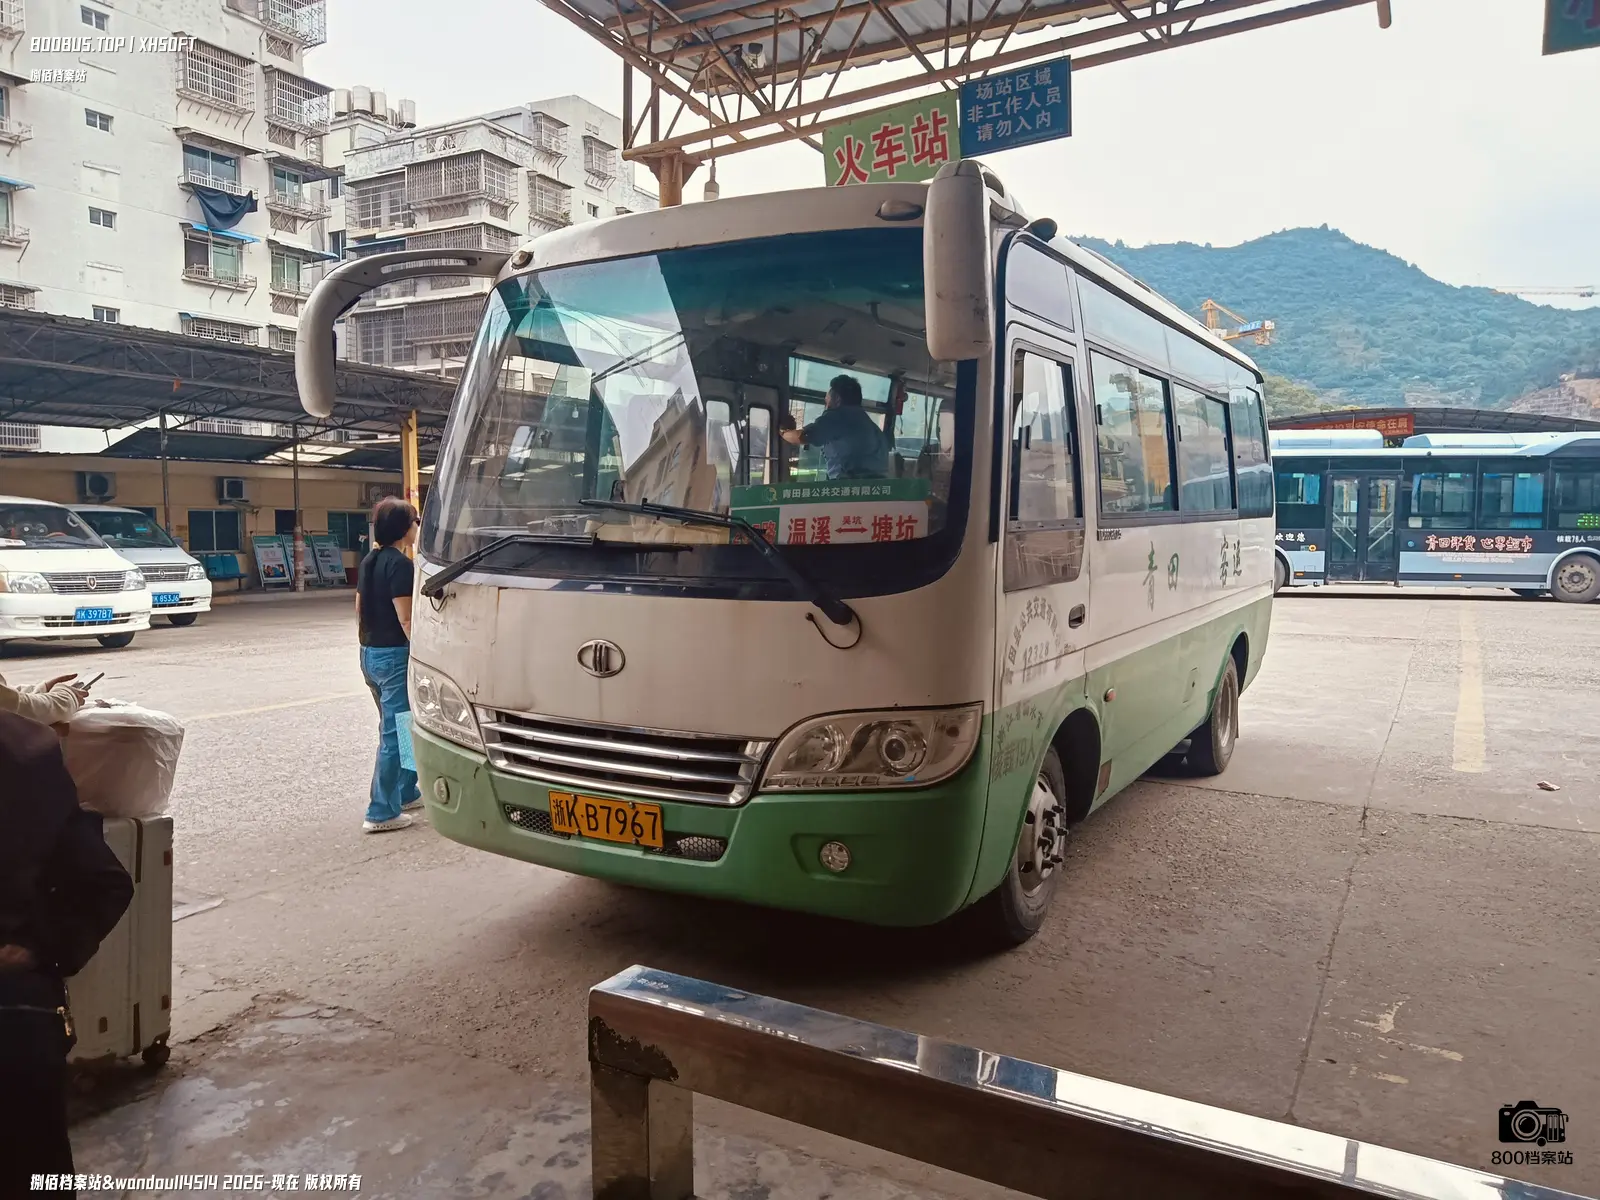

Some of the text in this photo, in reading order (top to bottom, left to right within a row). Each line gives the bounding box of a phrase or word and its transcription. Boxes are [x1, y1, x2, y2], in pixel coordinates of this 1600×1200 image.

[975, 67, 1052, 100] 场站区域
[967, 86, 1061, 123] 非工作人员
[976, 110, 1051, 142] 请勿入内
[833, 108, 949, 186] 火车站
[782, 485, 891, 499] 青田县公共交通有限公司
[787, 515, 831, 544] 温溪
[871, 514, 918, 542] 塘坑
